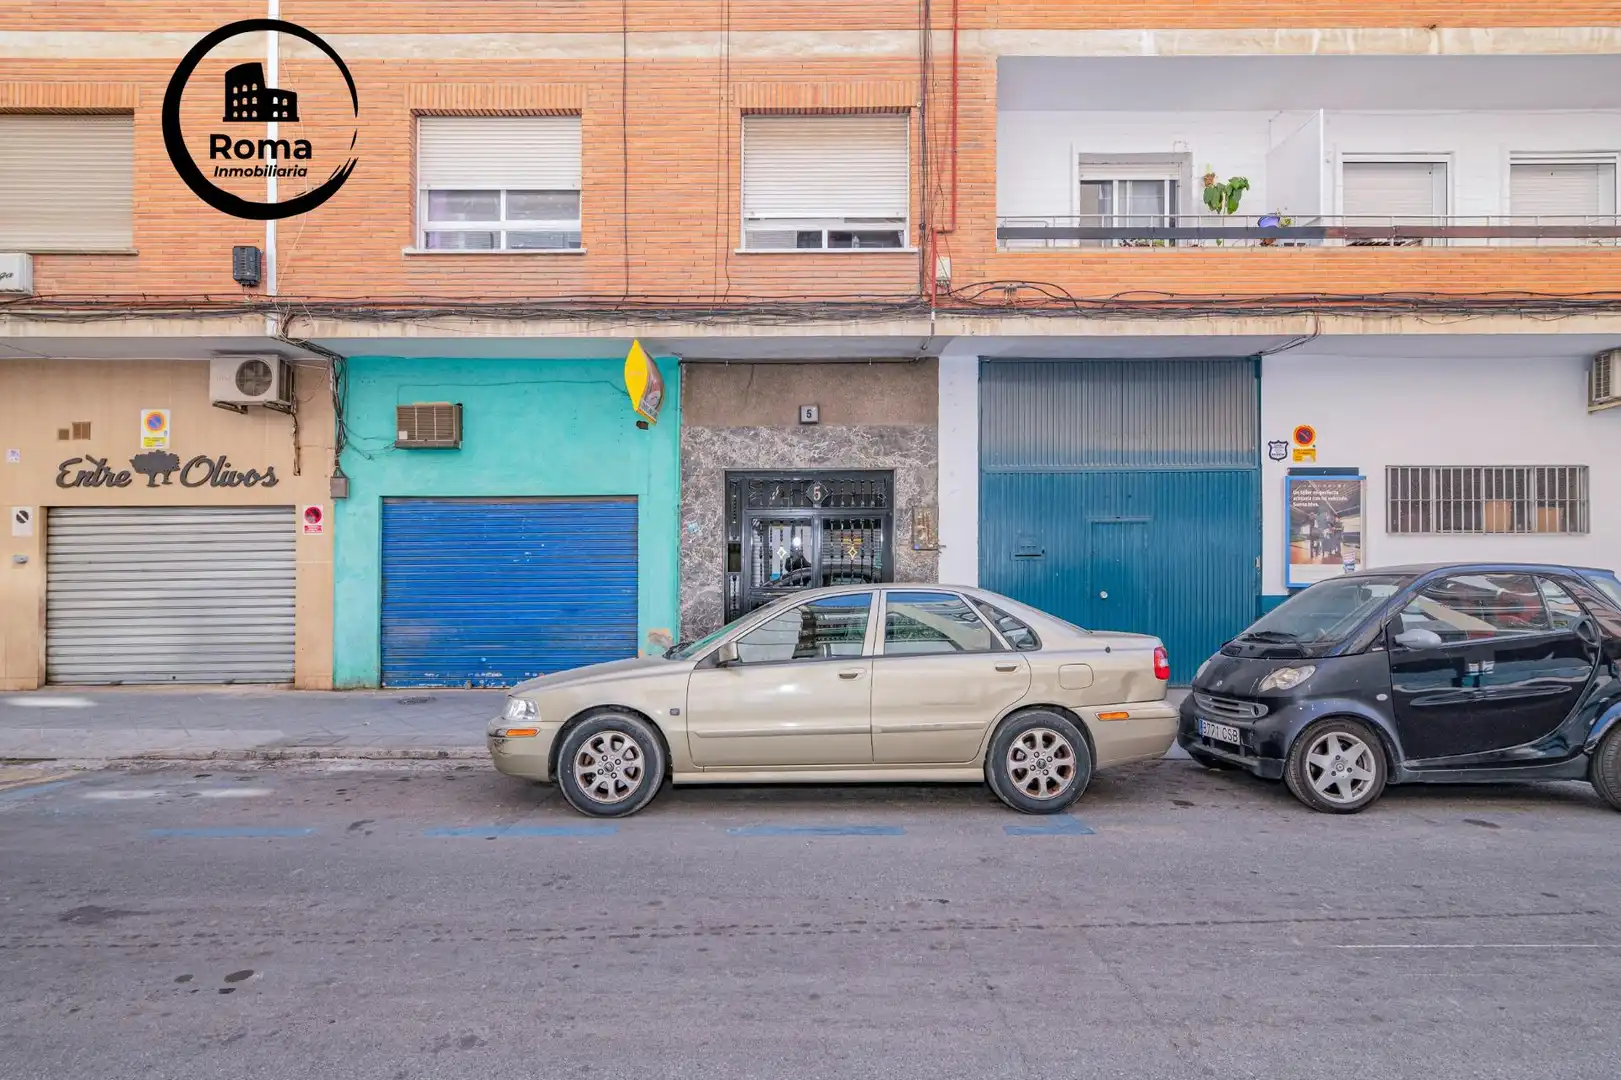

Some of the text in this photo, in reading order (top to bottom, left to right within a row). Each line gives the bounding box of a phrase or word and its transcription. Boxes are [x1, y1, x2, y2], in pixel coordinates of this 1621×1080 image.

[806, 408, 812, 419] 5
[55, 454, 279, 488] Entre Olivos
[813, 485, 821, 501] 5
[1222, 727, 1239, 743] CSB
